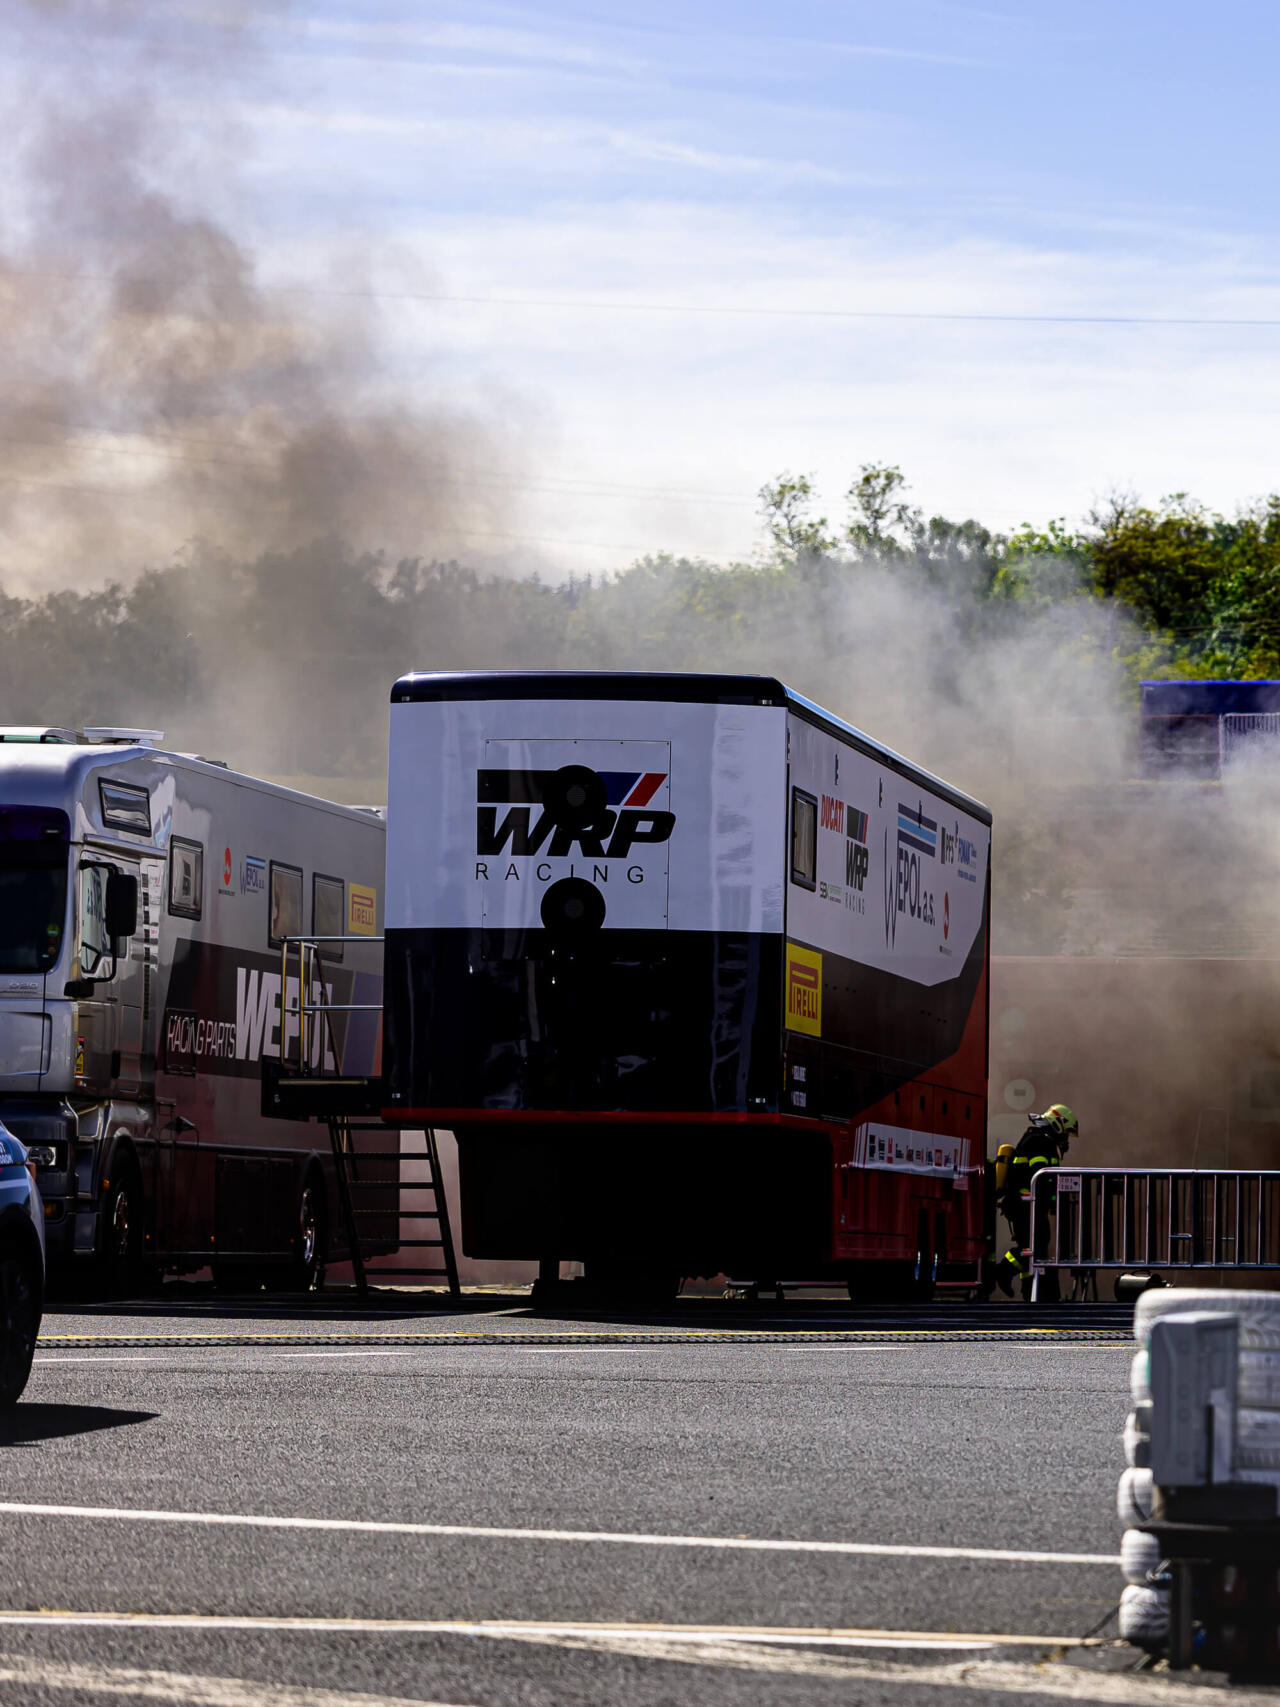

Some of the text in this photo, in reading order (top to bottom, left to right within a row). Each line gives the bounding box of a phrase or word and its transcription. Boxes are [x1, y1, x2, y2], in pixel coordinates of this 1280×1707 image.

[477, 807, 676, 858] WRP
[821, 794, 845, 834] DUCATI
[475, 863, 644, 883] RACING
[846, 839, 868, 891] WRP
[885, 826, 922, 950] WEPOL
[352, 894, 374, 926] PIRELLI
[789, 960, 819, 1020] PIRELLI
[167, 967, 336, 1071] RACING PARTS WEPOL
